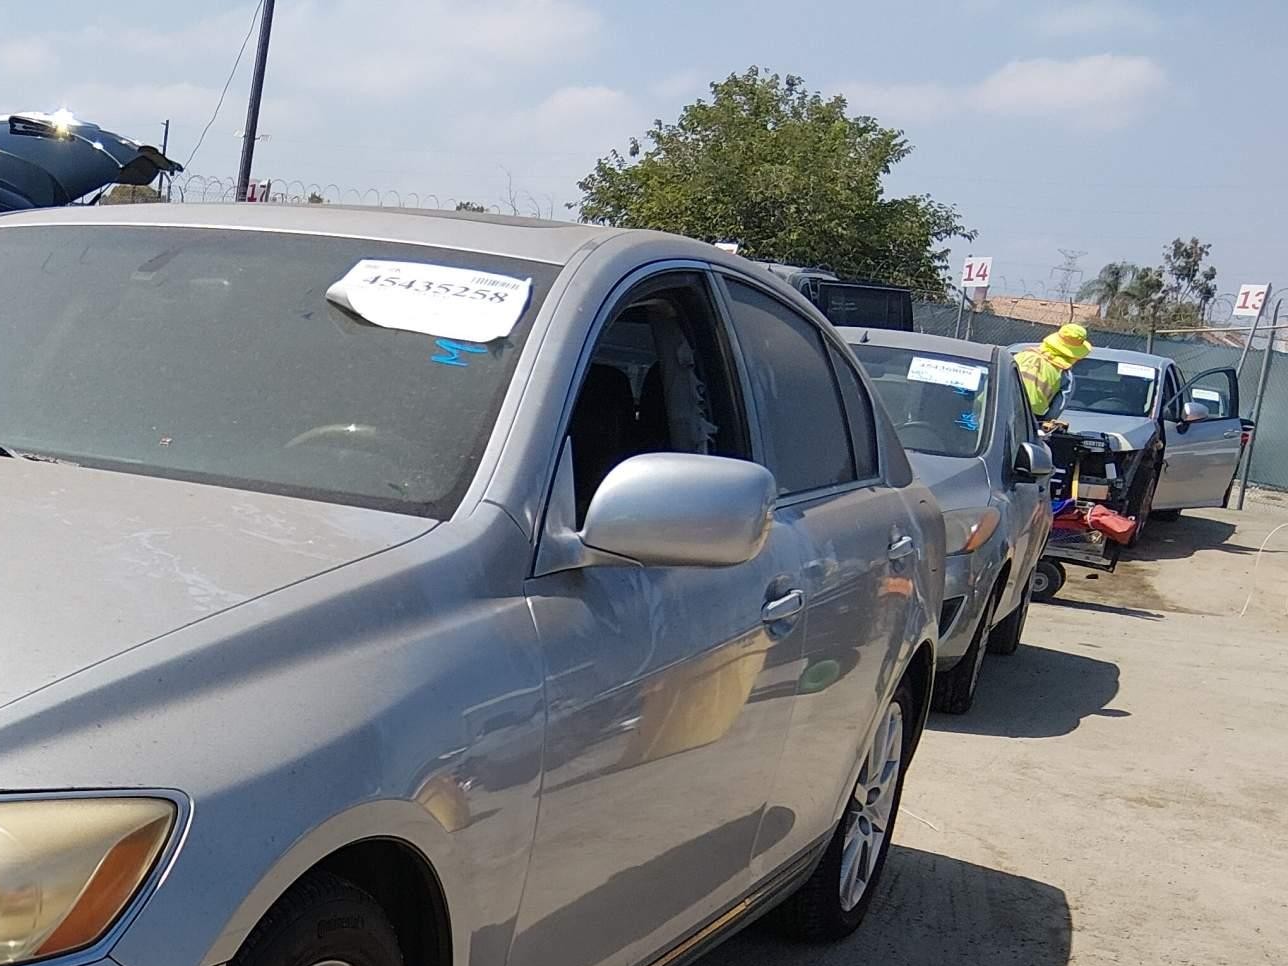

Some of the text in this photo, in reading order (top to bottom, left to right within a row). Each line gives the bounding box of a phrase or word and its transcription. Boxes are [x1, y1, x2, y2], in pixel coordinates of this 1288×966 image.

[247, 184, 267, 203] 17
[963, 262, 988, 282] 14
[363, 275, 508, 304] 45435258
[1237, 291, 1265, 310] 13
